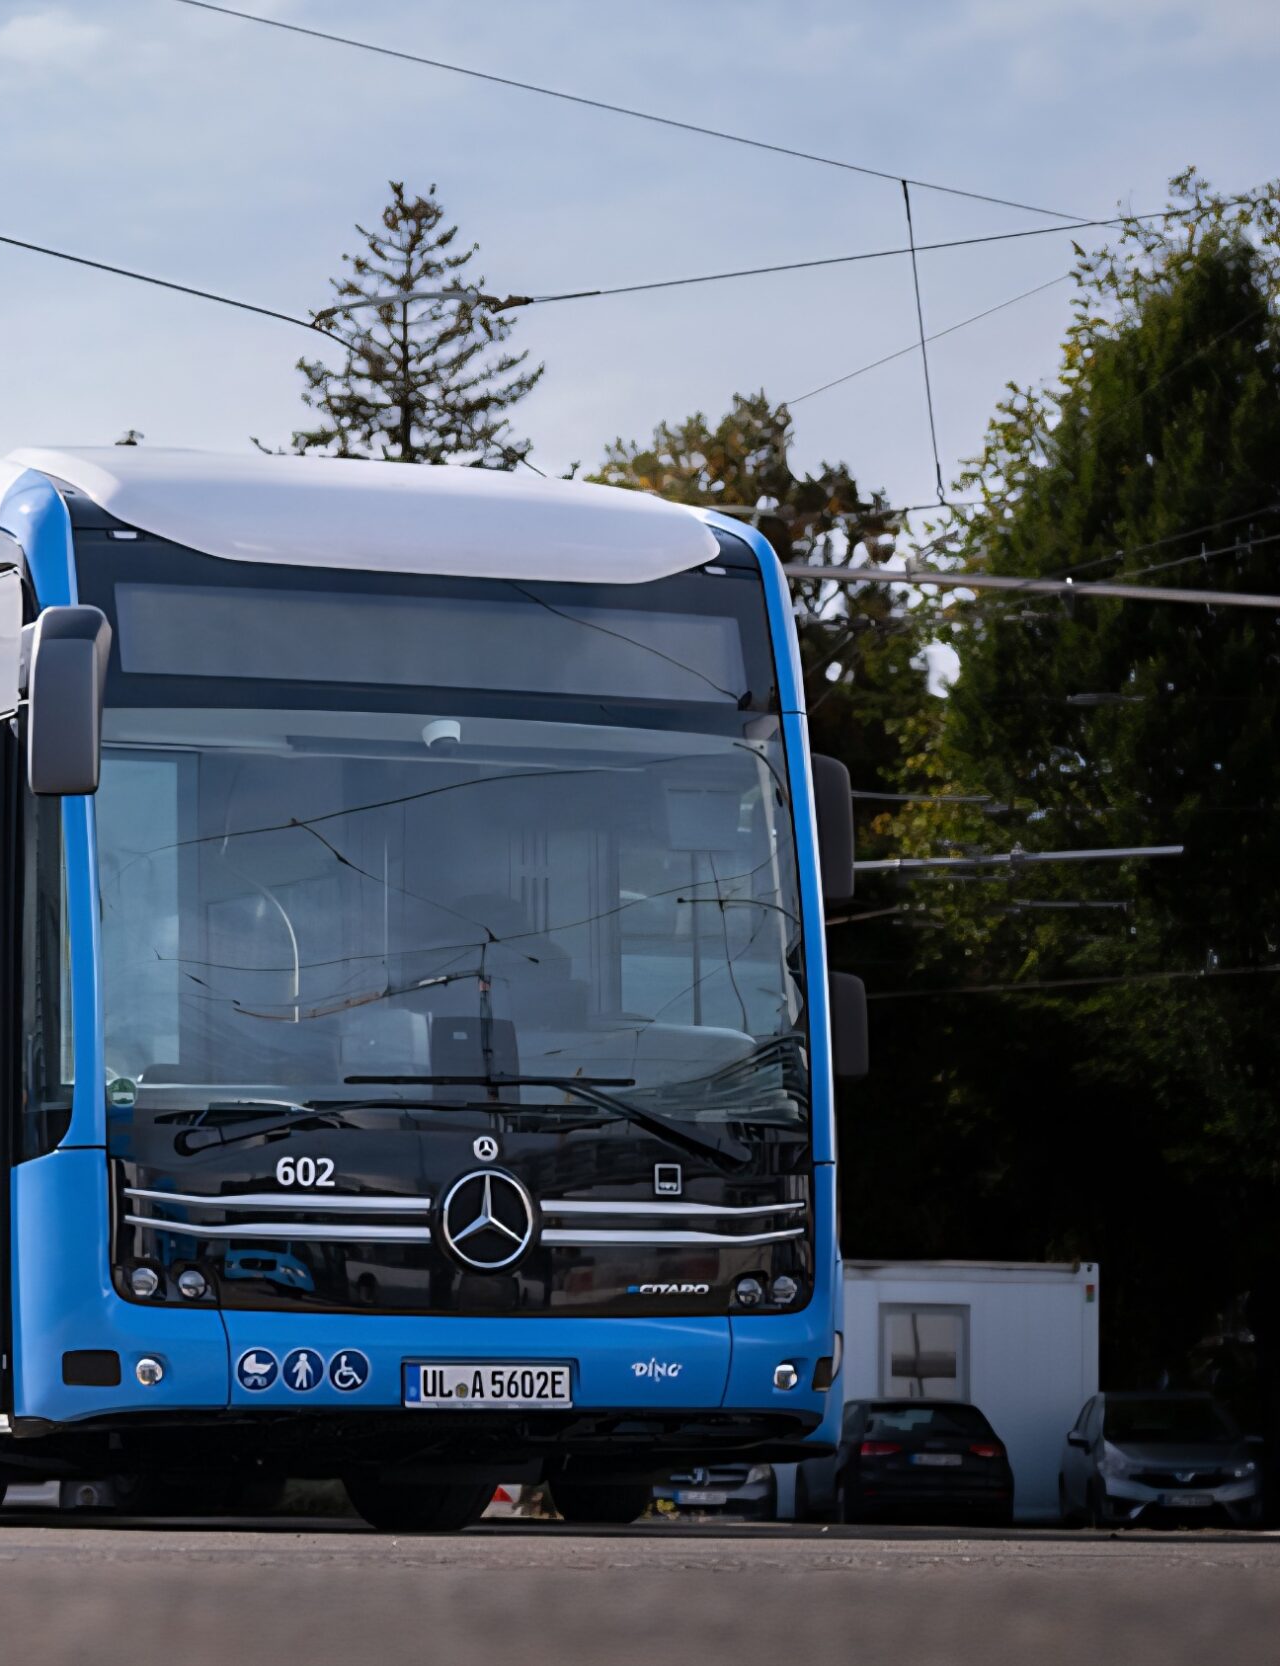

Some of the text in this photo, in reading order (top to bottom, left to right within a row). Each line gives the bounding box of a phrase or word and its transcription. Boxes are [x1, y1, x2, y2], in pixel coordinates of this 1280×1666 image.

[276, 1156, 336, 1187] 602
[422, 1369, 565, 1399] UL A 5602E
